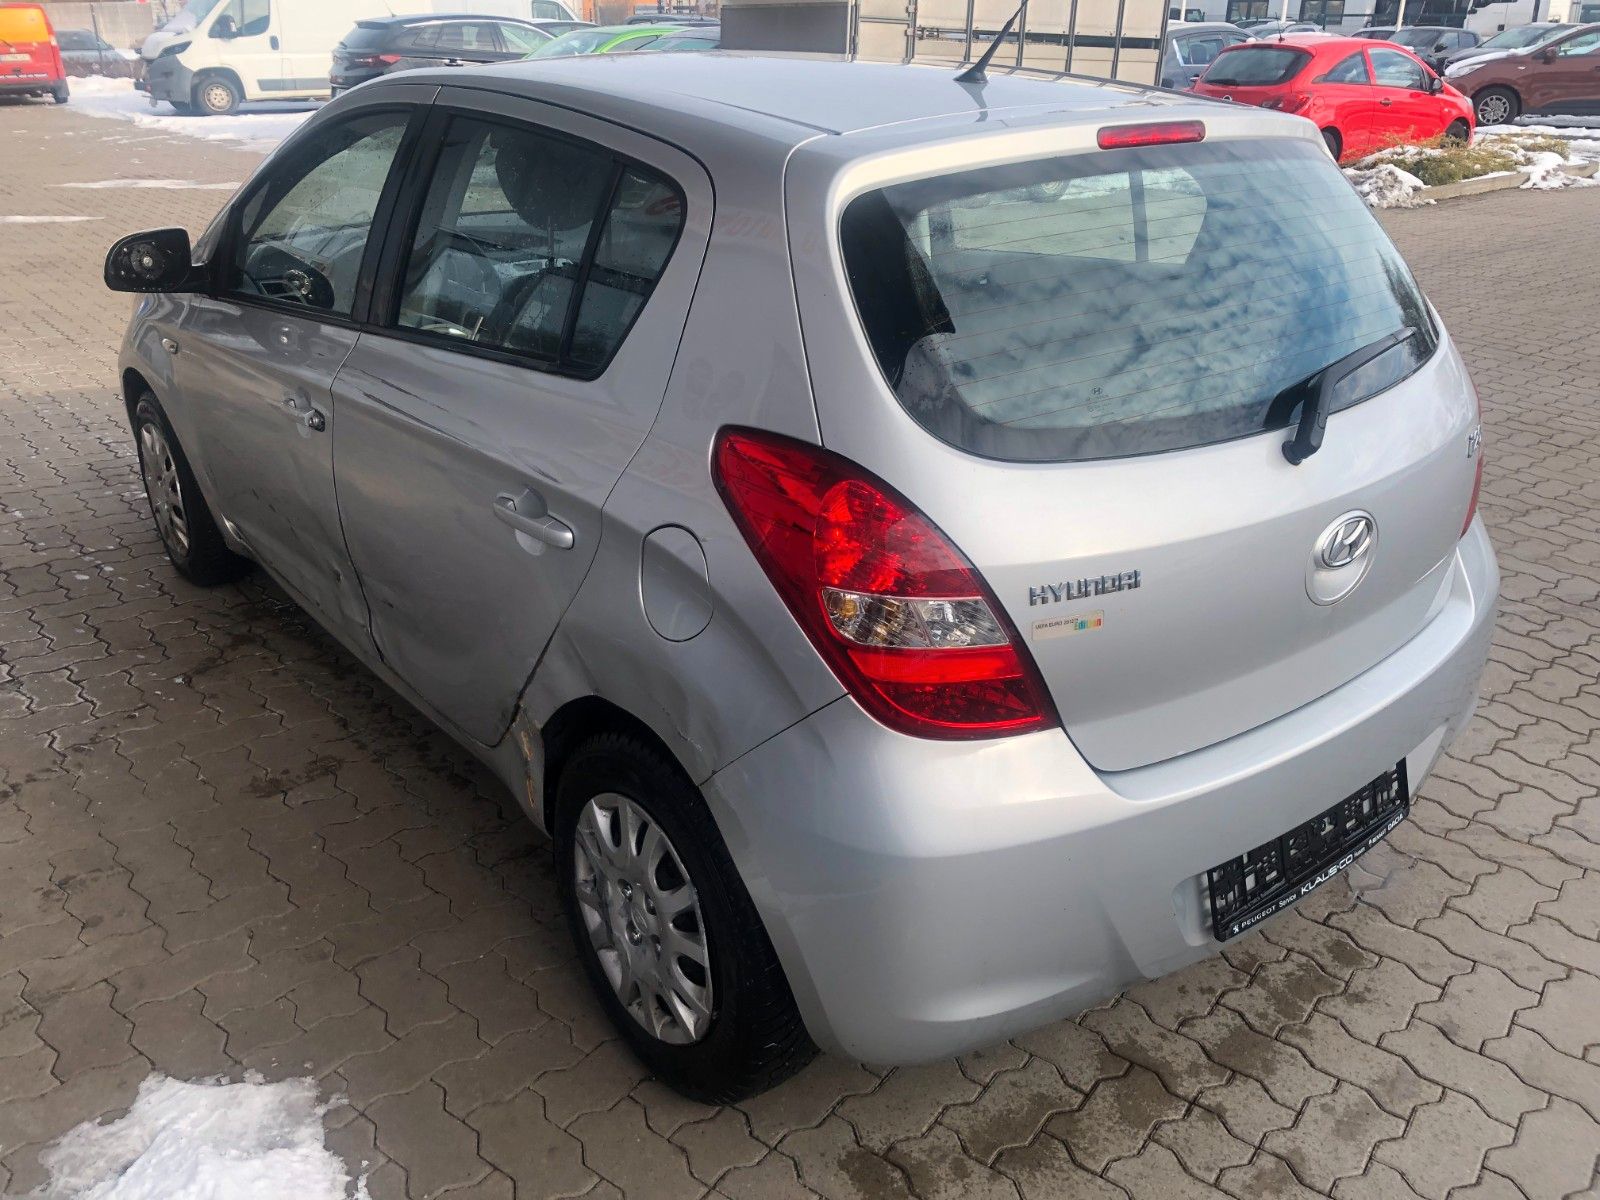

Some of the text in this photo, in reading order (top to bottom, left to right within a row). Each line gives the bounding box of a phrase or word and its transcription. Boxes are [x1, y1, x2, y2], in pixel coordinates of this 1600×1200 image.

[1029, 568, 1142, 606] HYUNDAI
[1049, 620, 1063, 628] EURO
[1241, 905, 1276, 929] PEUGEOT
[1278, 893, 1297, 908] Service
